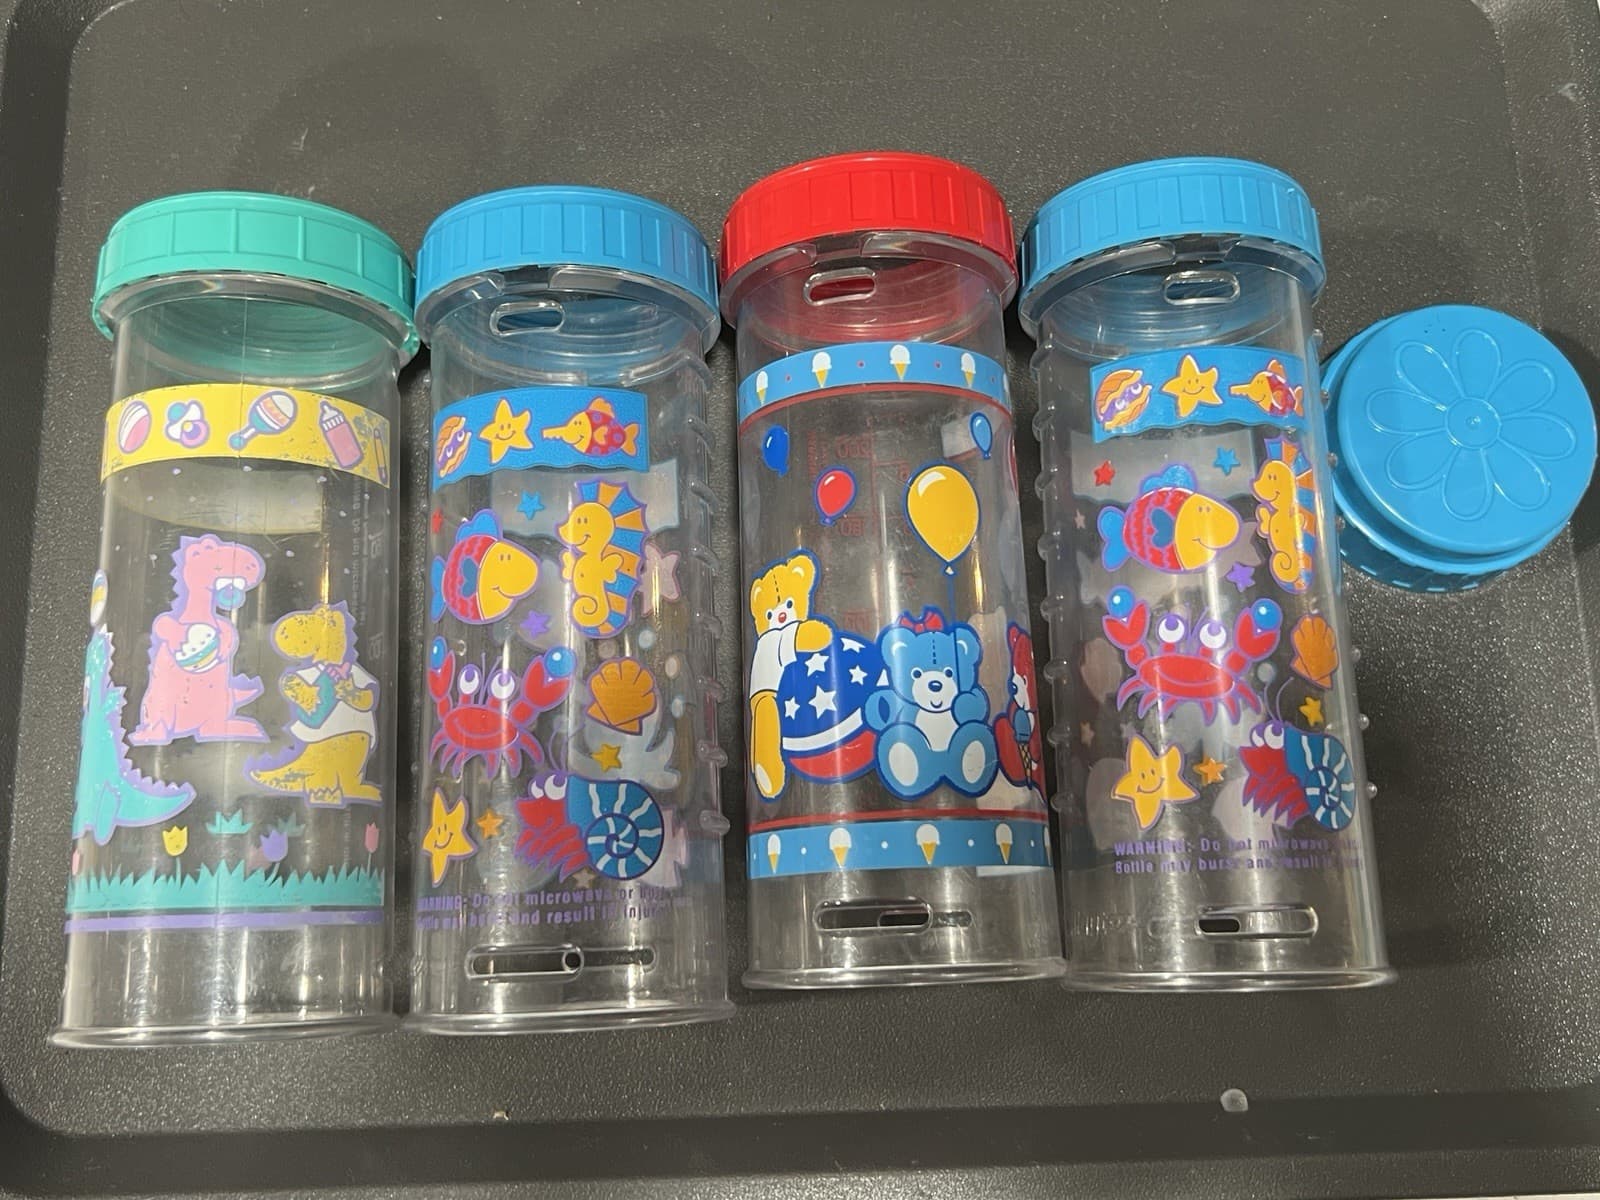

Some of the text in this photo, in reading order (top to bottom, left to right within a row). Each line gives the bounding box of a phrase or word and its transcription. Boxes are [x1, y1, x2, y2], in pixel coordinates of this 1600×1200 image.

[1114, 838, 1192, 857] WARNING:
[1200, 837, 1221, 852] Do
[1258, 836, 1329, 850] miowave
[1115, 860, 1153, 874] Bottle
[472, 893, 490, 908] Do
[495, 892, 519, 907] ot
[547, 904, 595, 924] result
